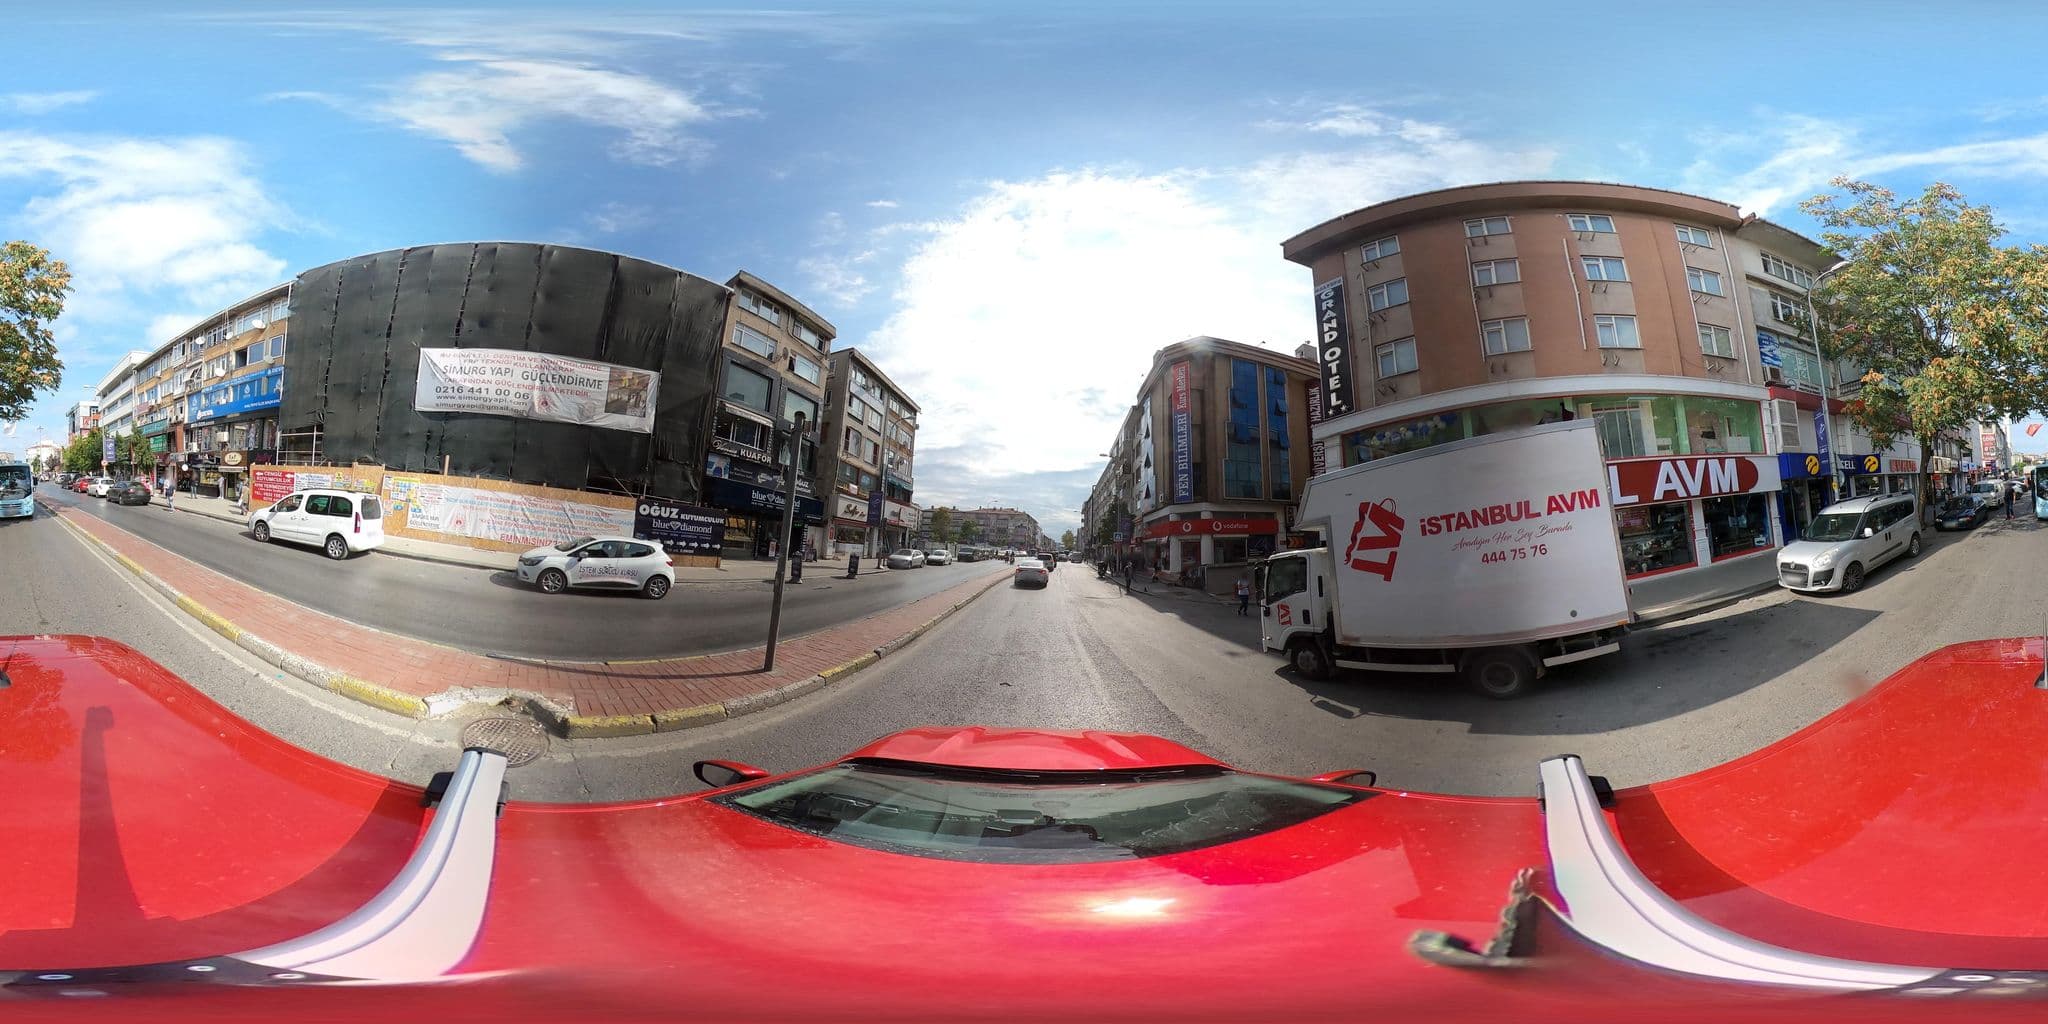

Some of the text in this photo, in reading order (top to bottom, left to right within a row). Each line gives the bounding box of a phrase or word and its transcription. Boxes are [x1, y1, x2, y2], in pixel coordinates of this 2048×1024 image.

[1320, 289, 1338, 344] GRAND
[443, 365, 604, 390] SİMURG YAPI GÜÇLENDİRME
[1324, 347, 1342, 407] OTEL
[435, 385, 530, 400] 0216 441 00 06
[1309, 387, 1321, 422] HAZIRLIK
[1175, 413, 1188, 470] BİLİMLERİ
[1178, 473, 1189, 497] FEN
[1653, 457, 1741, 501] AVM
[751, 490, 767, 501] blue
[774, 495, 801, 508] diand
[1546, 488, 1601, 516] AVM
[638, 502, 680, 519] OĞUZ
[680, 513, 725, 524] KUYUMCULUK
[652, 518, 712, 534] blue diamond
[1481, 544, 1548, 565] 444 75 76
